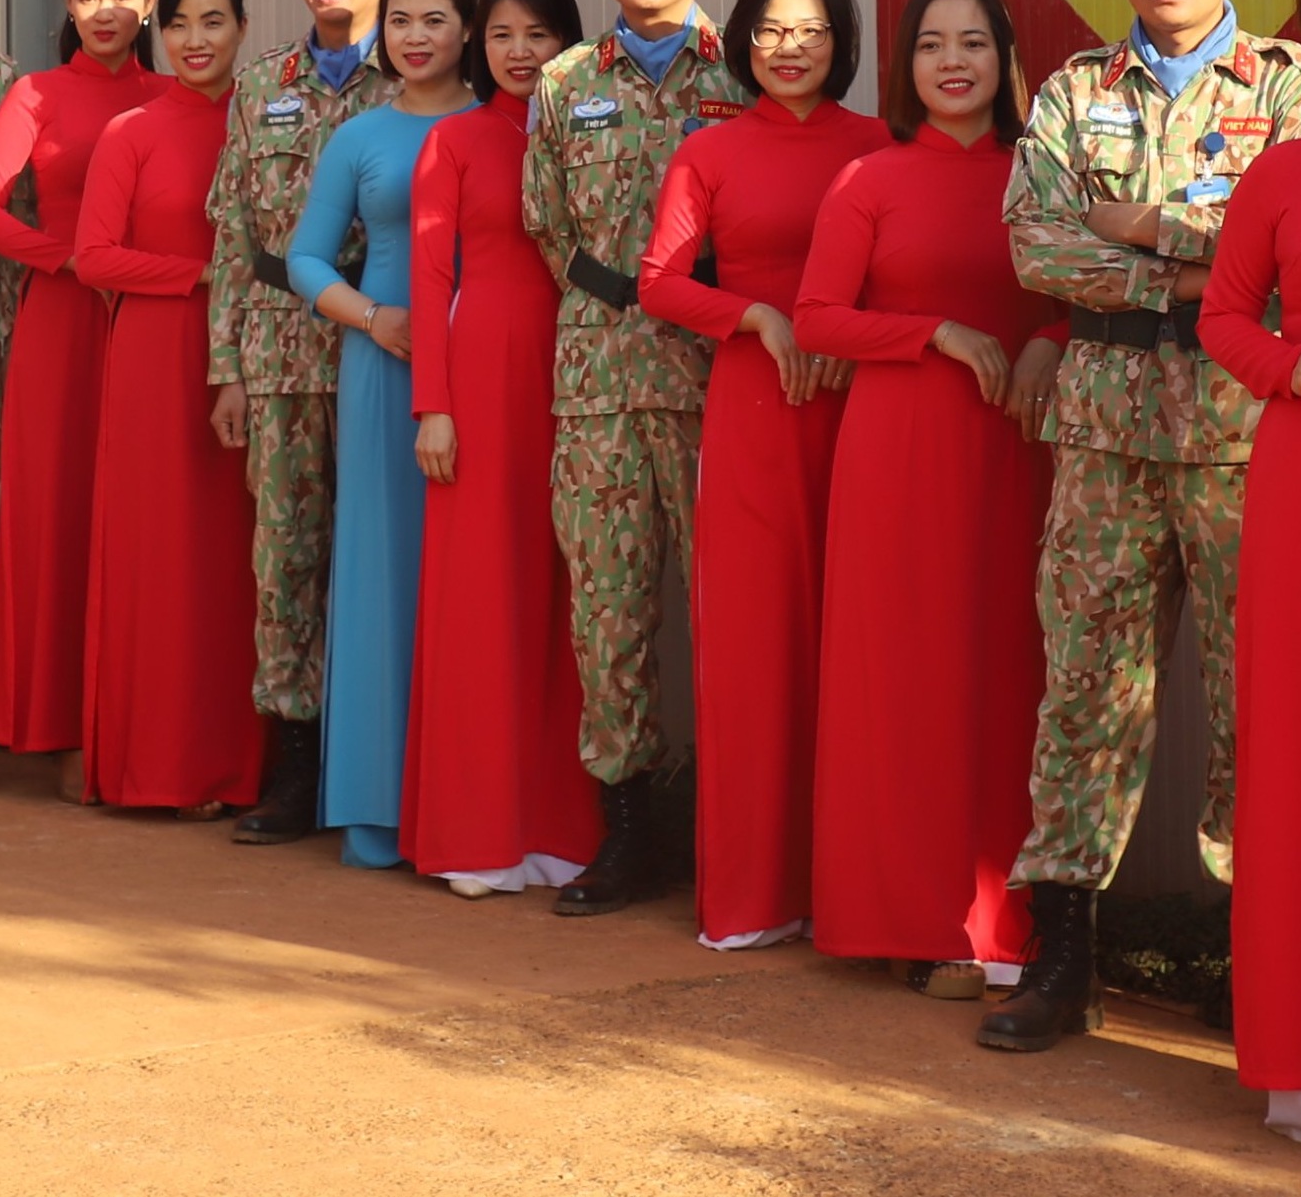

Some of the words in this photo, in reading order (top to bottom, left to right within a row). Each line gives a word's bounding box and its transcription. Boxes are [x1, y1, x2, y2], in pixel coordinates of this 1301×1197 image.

[701, 104, 720, 114] VIET
[1224, 121, 1245, 131] VIET
[1247, 121, 1269, 133] NAM
